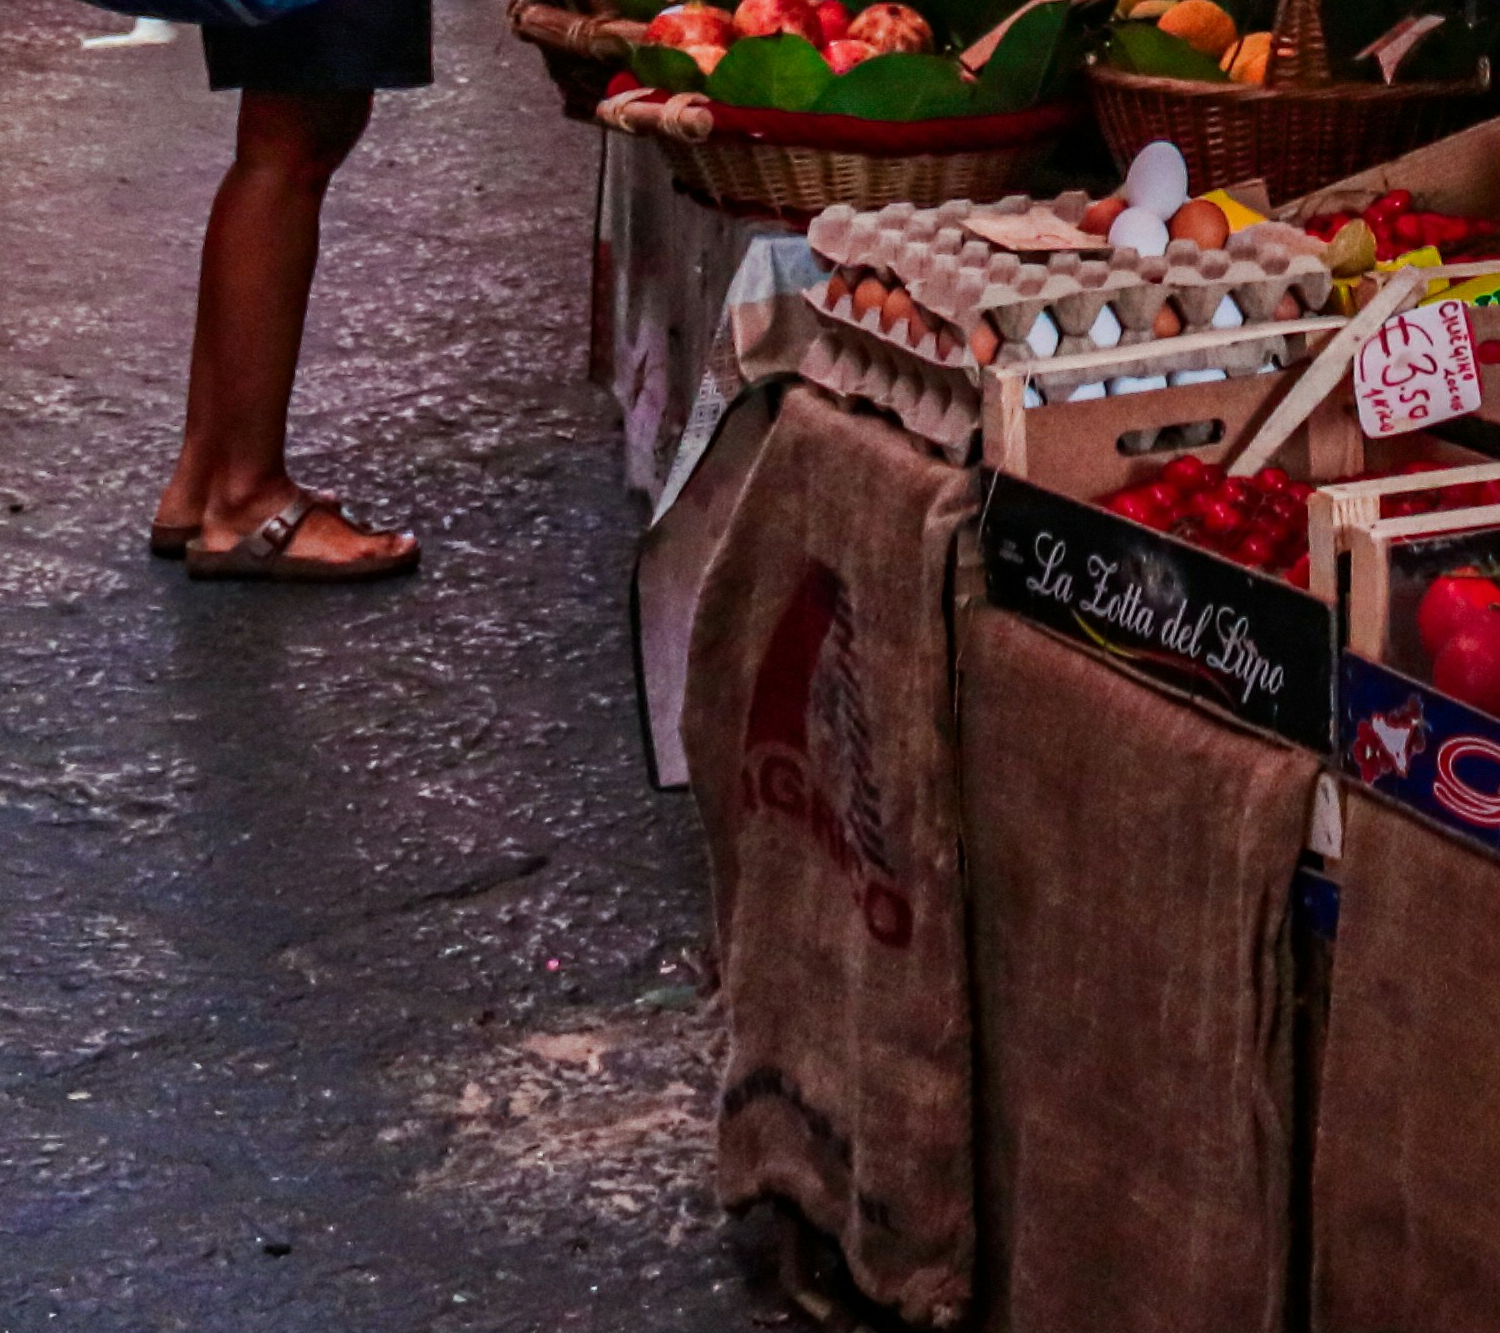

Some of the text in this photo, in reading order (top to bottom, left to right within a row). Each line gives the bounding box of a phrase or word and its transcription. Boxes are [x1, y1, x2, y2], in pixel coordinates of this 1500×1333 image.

[1026, 531, 1074, 604] La
[1160, 596, 1215, 659] del
[1205, 605, 1285, 704] Lupo
